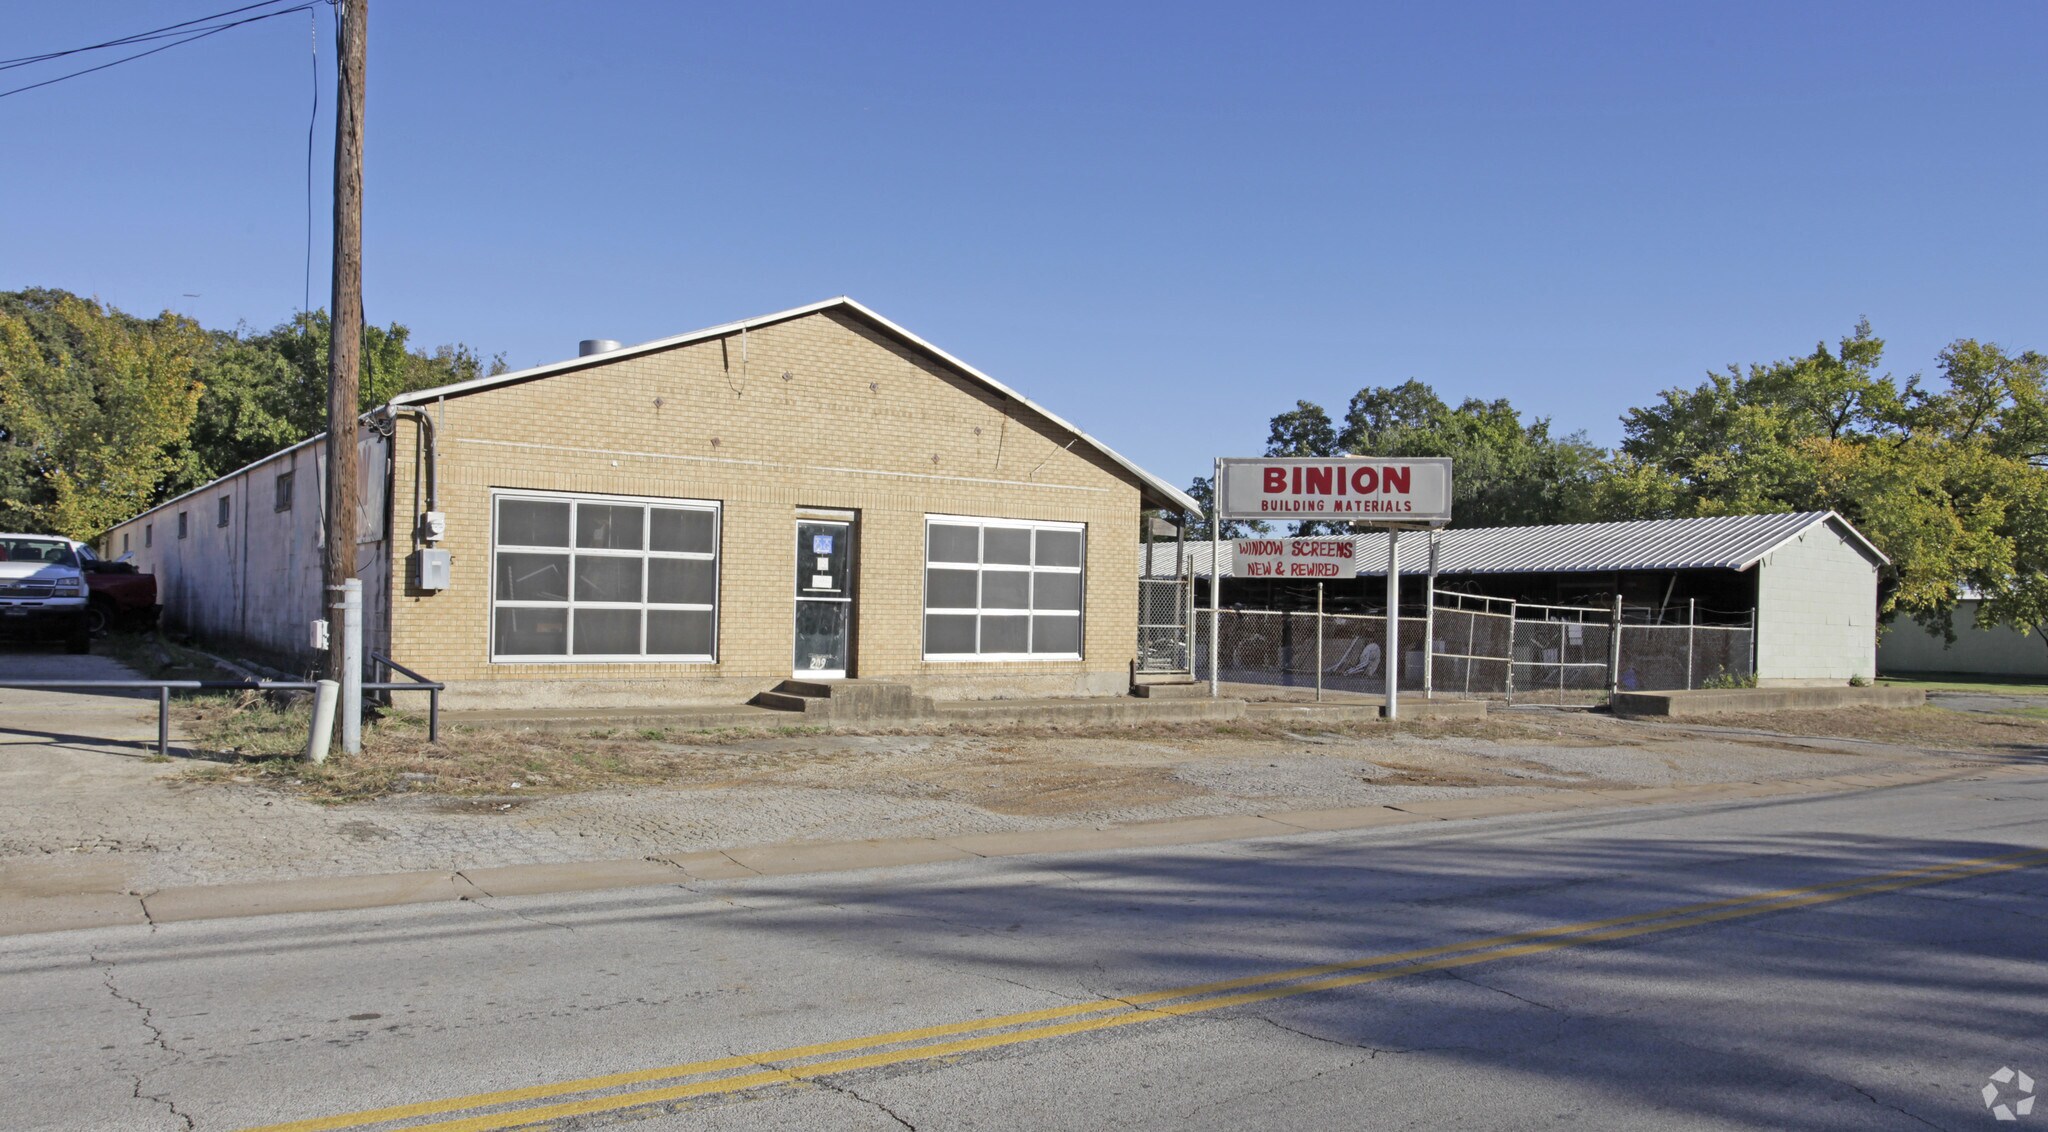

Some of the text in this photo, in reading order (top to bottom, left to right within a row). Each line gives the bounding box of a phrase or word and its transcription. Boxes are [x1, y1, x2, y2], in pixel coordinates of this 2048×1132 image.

[1263, 466, 1411, 496] BINION
[1261, 500, 1412, 513] BUILDING MATERIALS
[1239, 541, 1353, 559] WINDOW SCREENS
[1247, 561, 1340, 577] NEW & REWIRED
